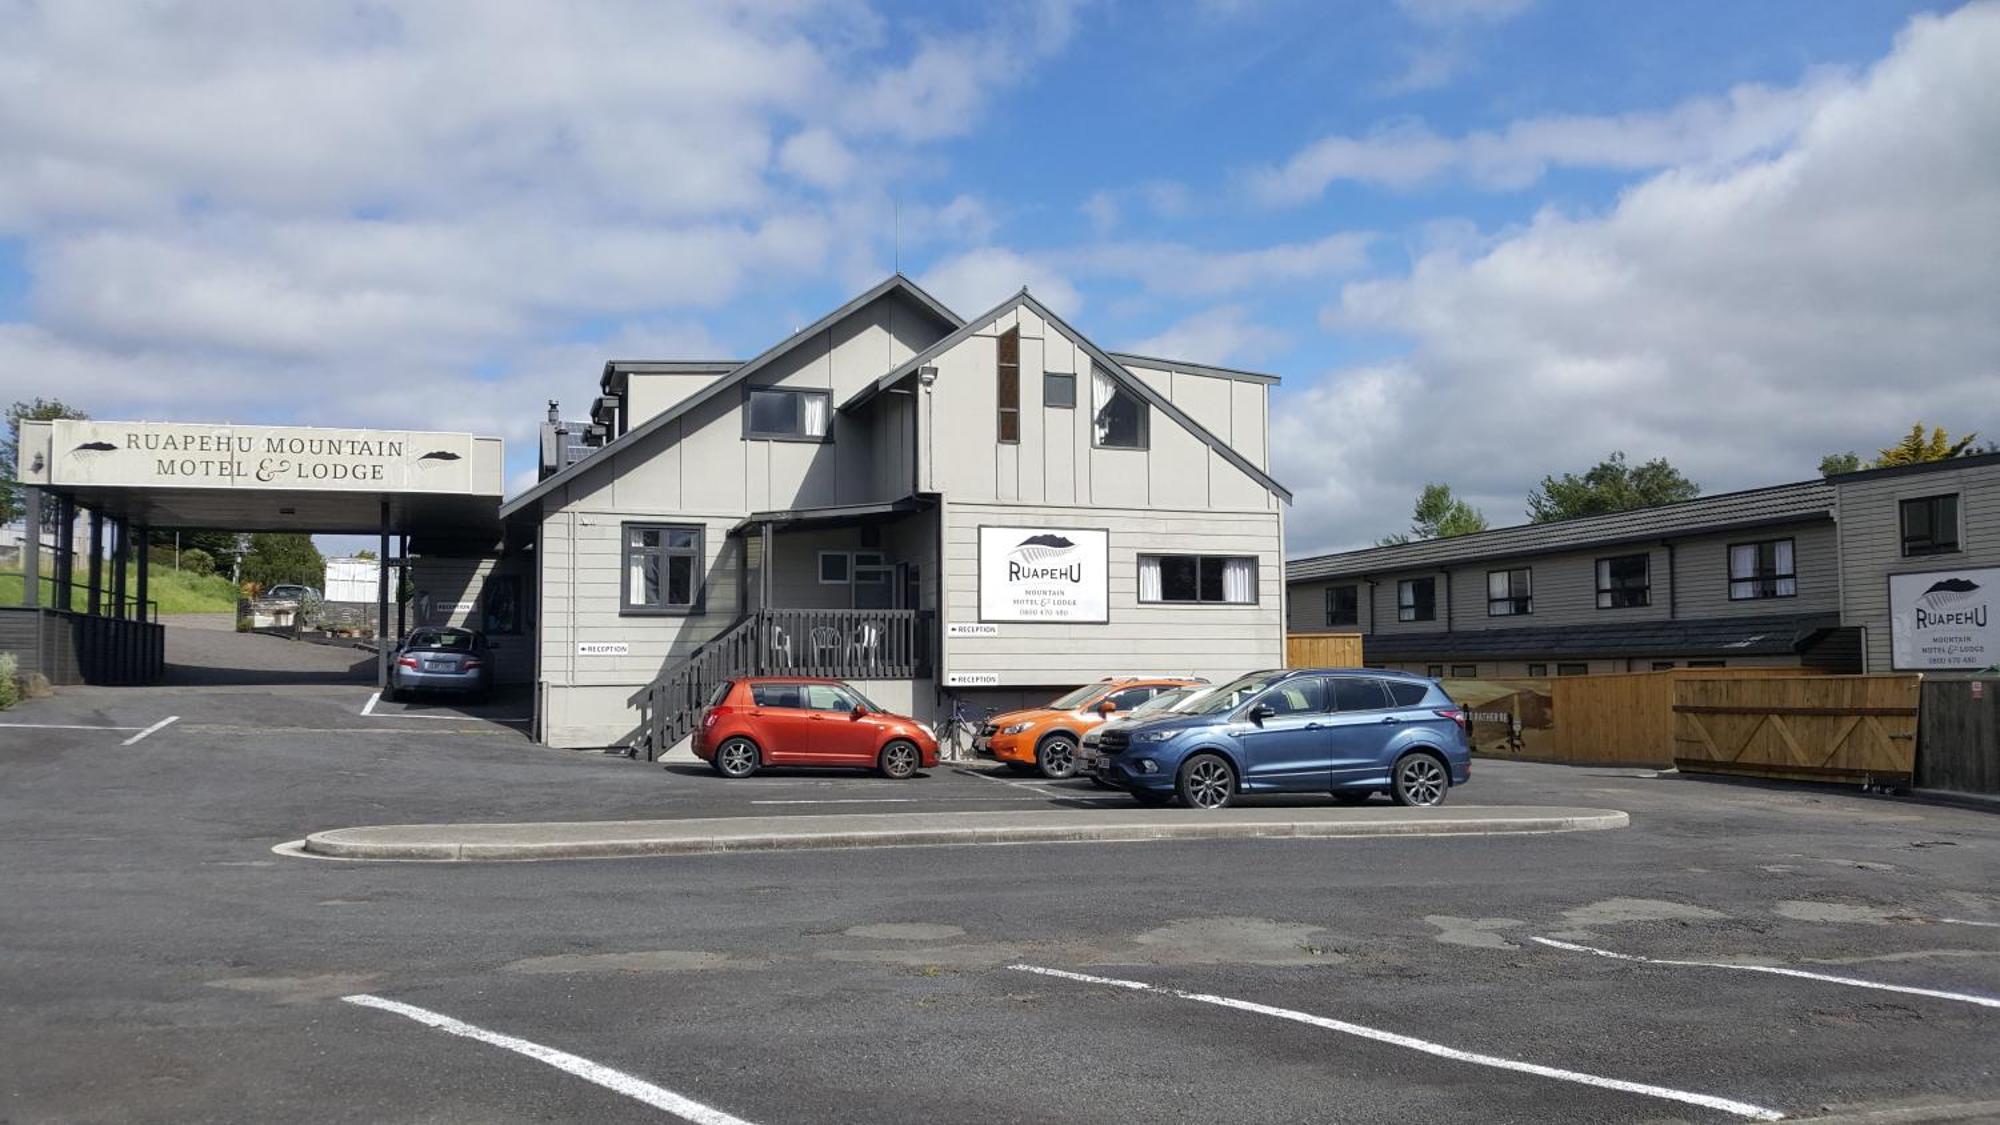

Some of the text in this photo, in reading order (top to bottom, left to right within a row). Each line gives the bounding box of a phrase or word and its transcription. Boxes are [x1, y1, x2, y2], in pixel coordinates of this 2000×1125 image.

[126, 433, 404, 457] RUAPEHU MOUNTAIN
[156, 457, 385, 482] MOTEL & LODGE
[1008, 560, 1081, 583] RUAPEHU
[1915, 605, 1988, 630] RUAPEHU
[958, 625, 996, 633] RECEPTION
[1932, 636, 1972, 644] MOUNTAIN
[587, 645, 628, 653] RECEPTION
[1959, 645, 1985, 653] LODGE
